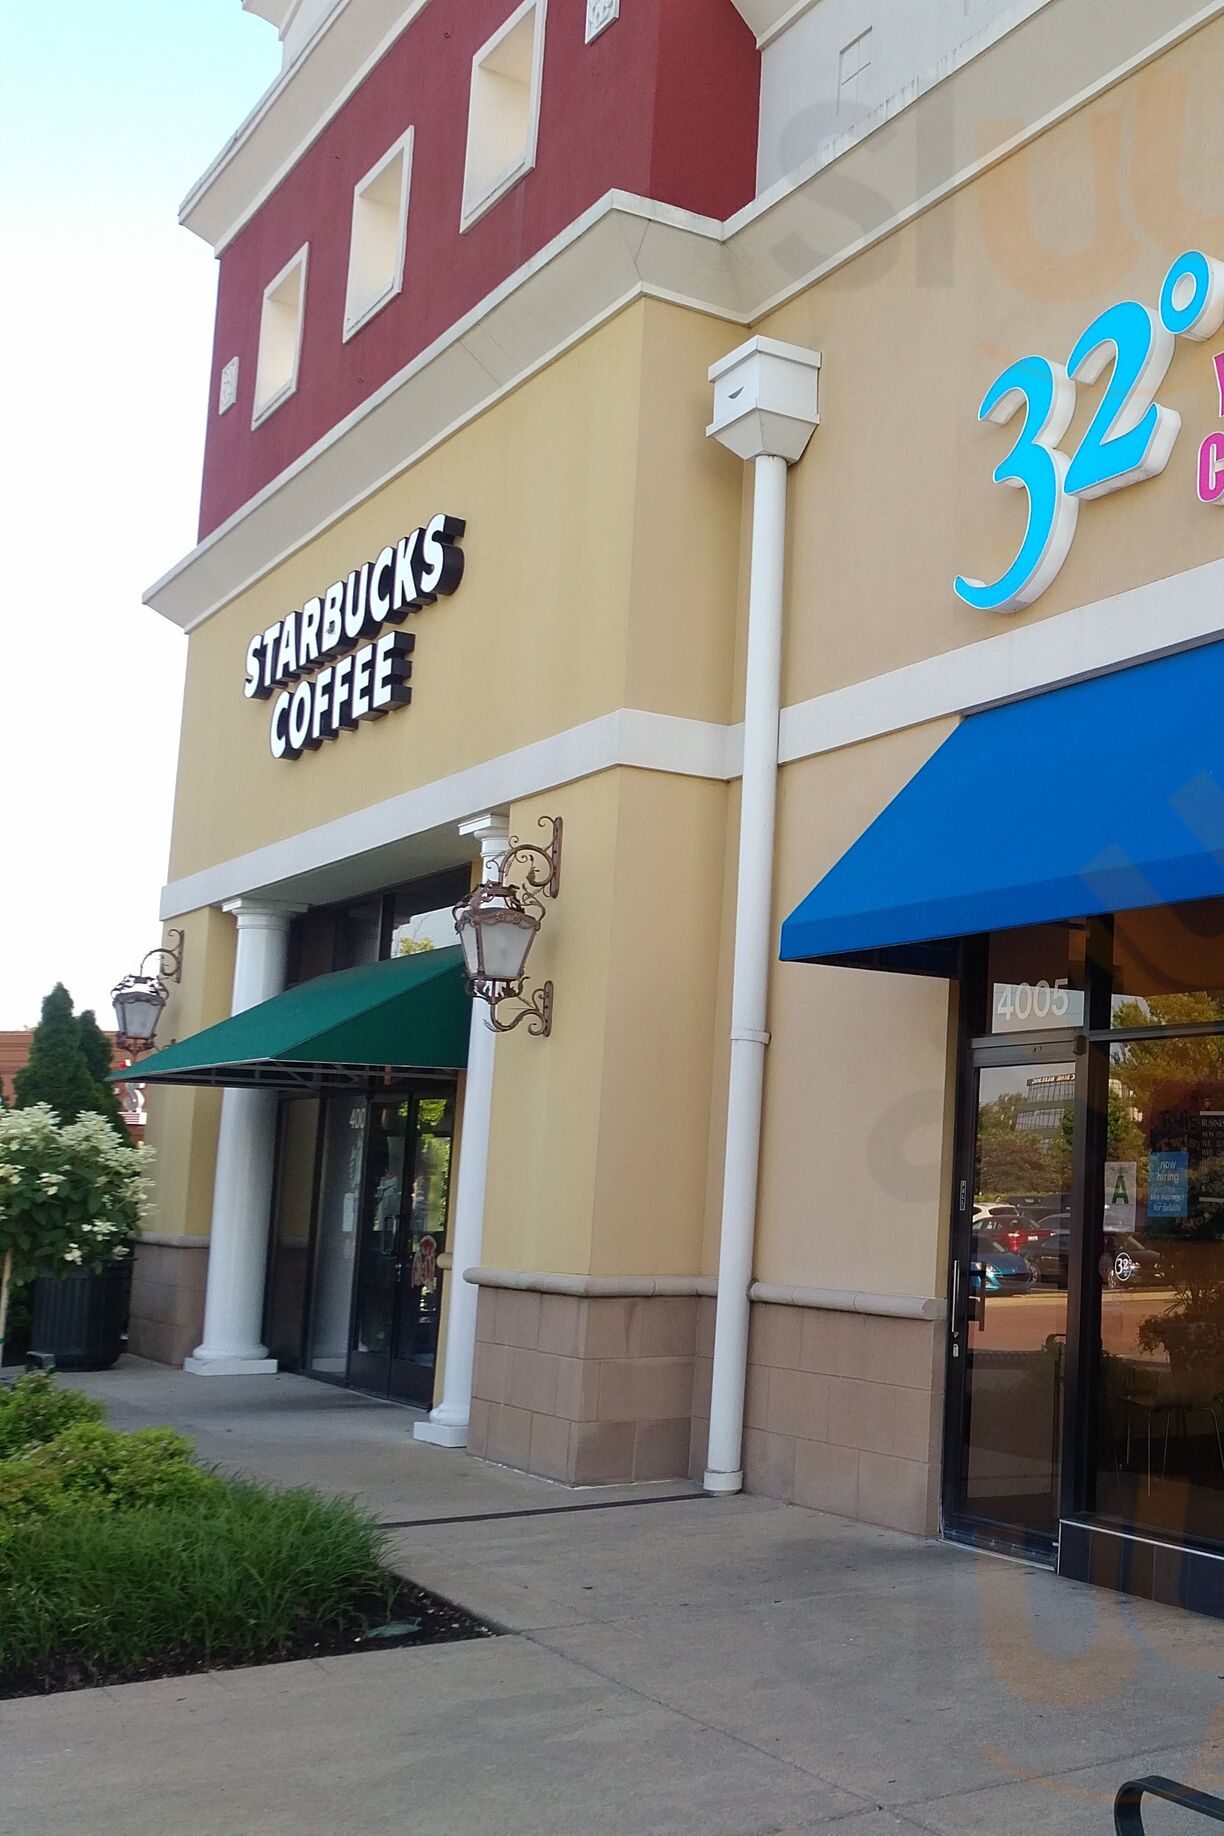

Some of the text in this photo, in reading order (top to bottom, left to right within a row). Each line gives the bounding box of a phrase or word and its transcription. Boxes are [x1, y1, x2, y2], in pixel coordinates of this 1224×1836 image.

[244, 513, 462, 699] STARBUCKS
[270, 631, 408, 760] COFFEE
[997, 978, 1069, 1020] 4005
[1157, 1170, 1180, 1184] hiring
[1160, 1161, 1177, 1169] now
[1111, 1175, 1129, 1205] A
